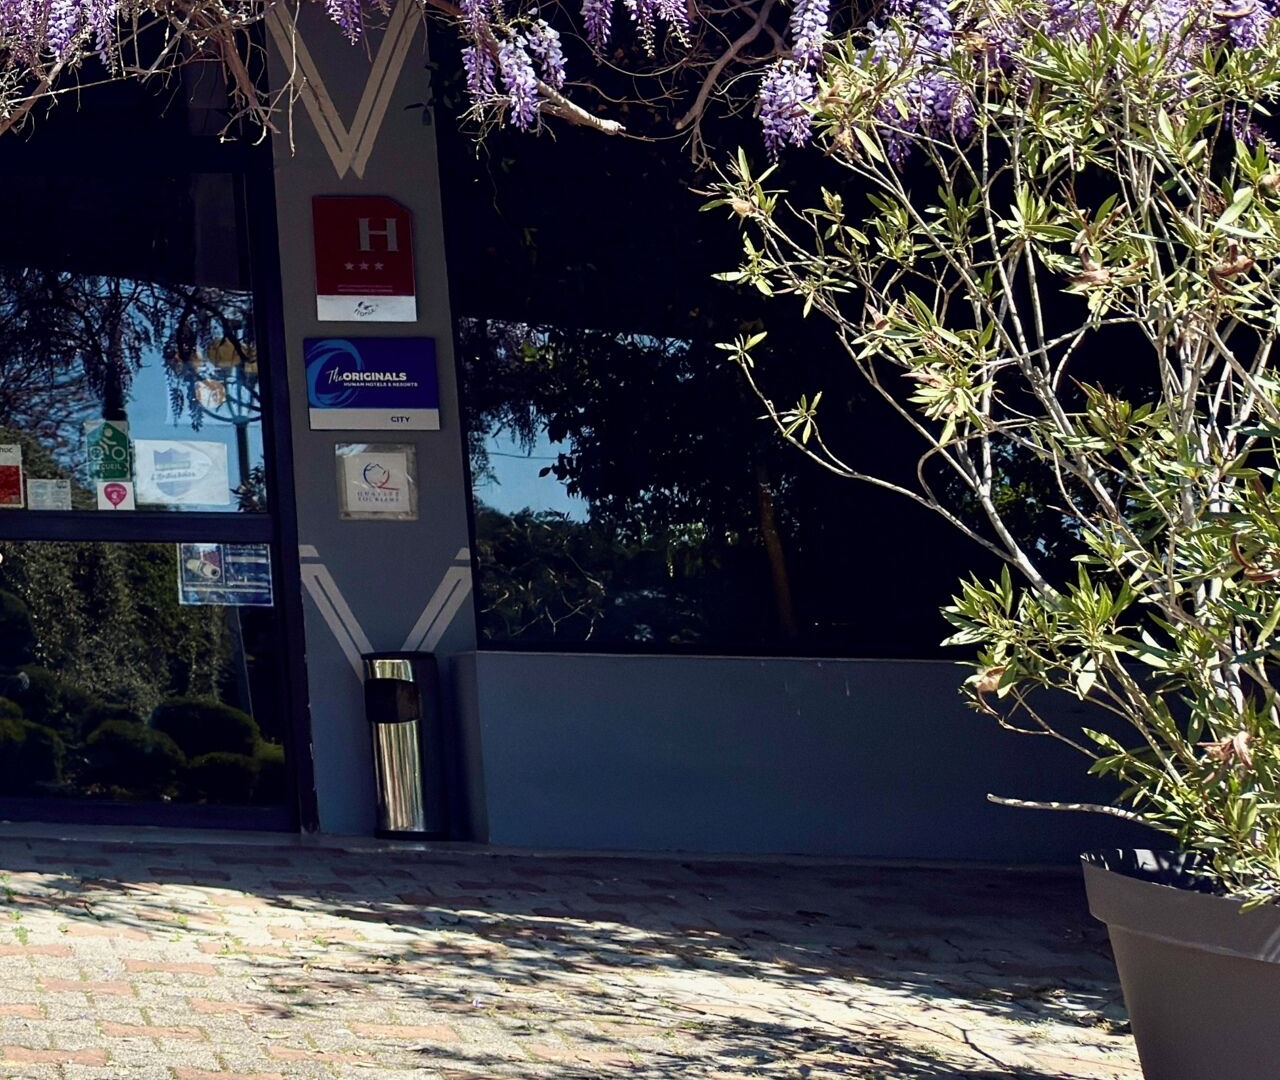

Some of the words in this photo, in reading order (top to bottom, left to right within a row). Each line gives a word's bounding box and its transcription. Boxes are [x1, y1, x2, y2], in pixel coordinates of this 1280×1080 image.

[358, 217, 400, 252] H
[326, 366, 344, 384] The
[343, 372, 407, 381] ORIGINALS
